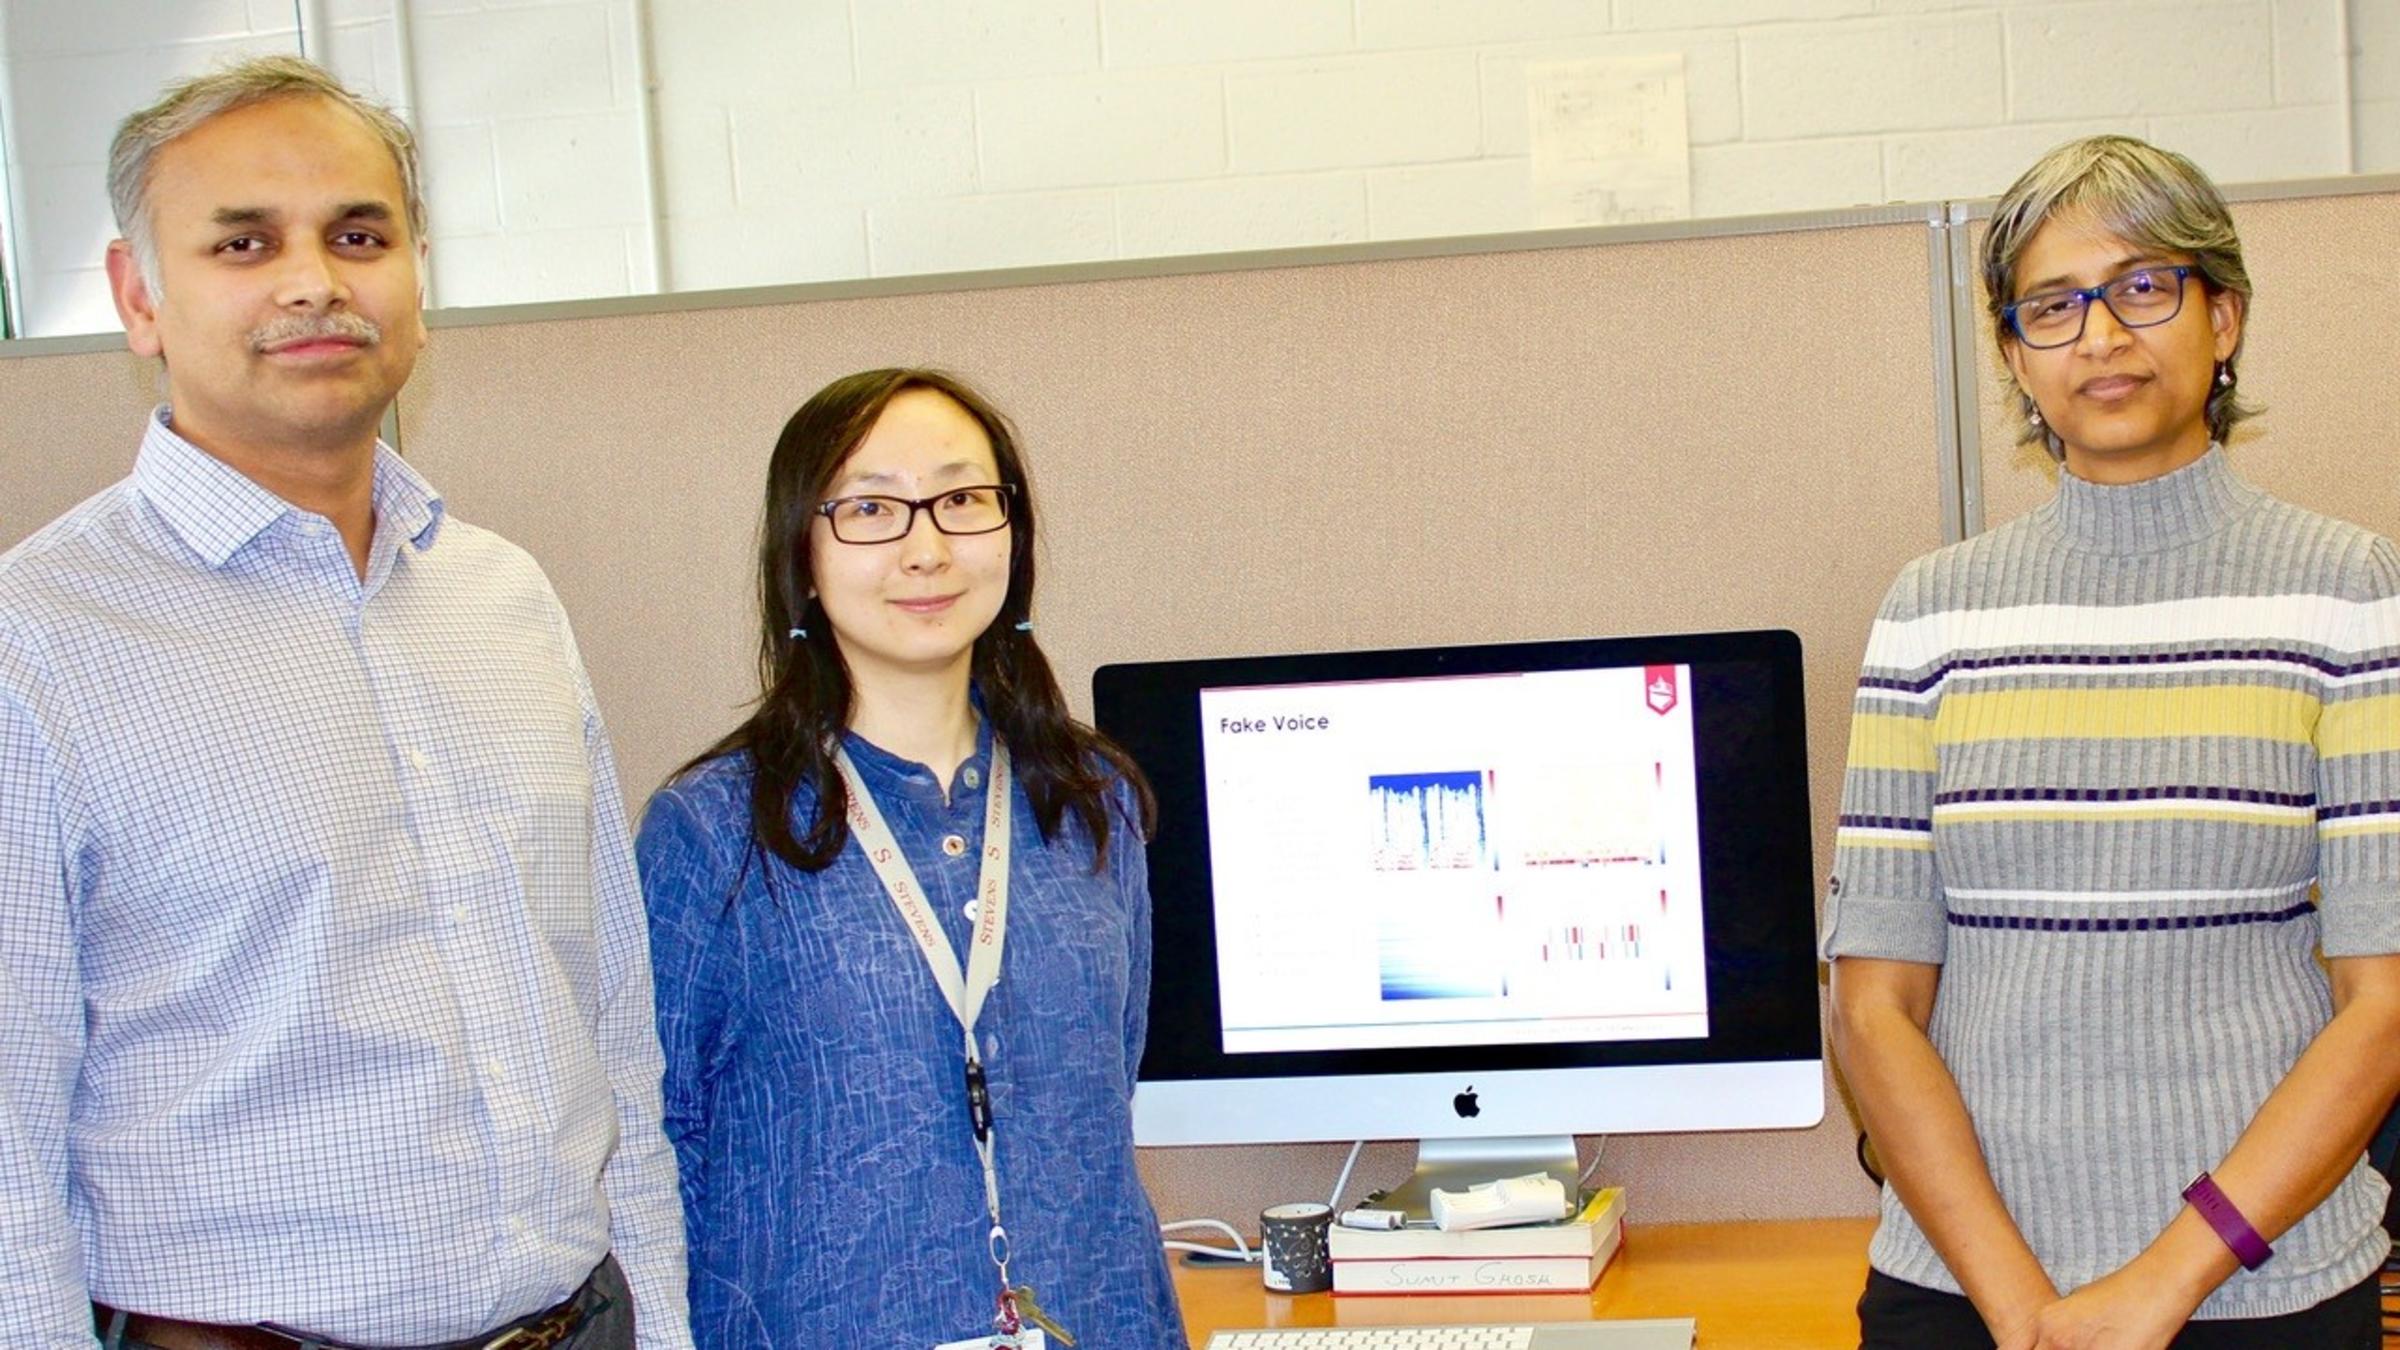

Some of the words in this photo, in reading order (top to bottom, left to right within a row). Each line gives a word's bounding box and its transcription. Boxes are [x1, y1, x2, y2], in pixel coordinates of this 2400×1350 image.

[1221, 718, 1266, 733] Fake
[1273, 714, 1329, 730] Voice
[873, 848, 892, 863] S
[988, 846, 1000, 860] S
[893, 881, 937, 947] STEVENS
[980, 879, 997, 946] STEVENS
